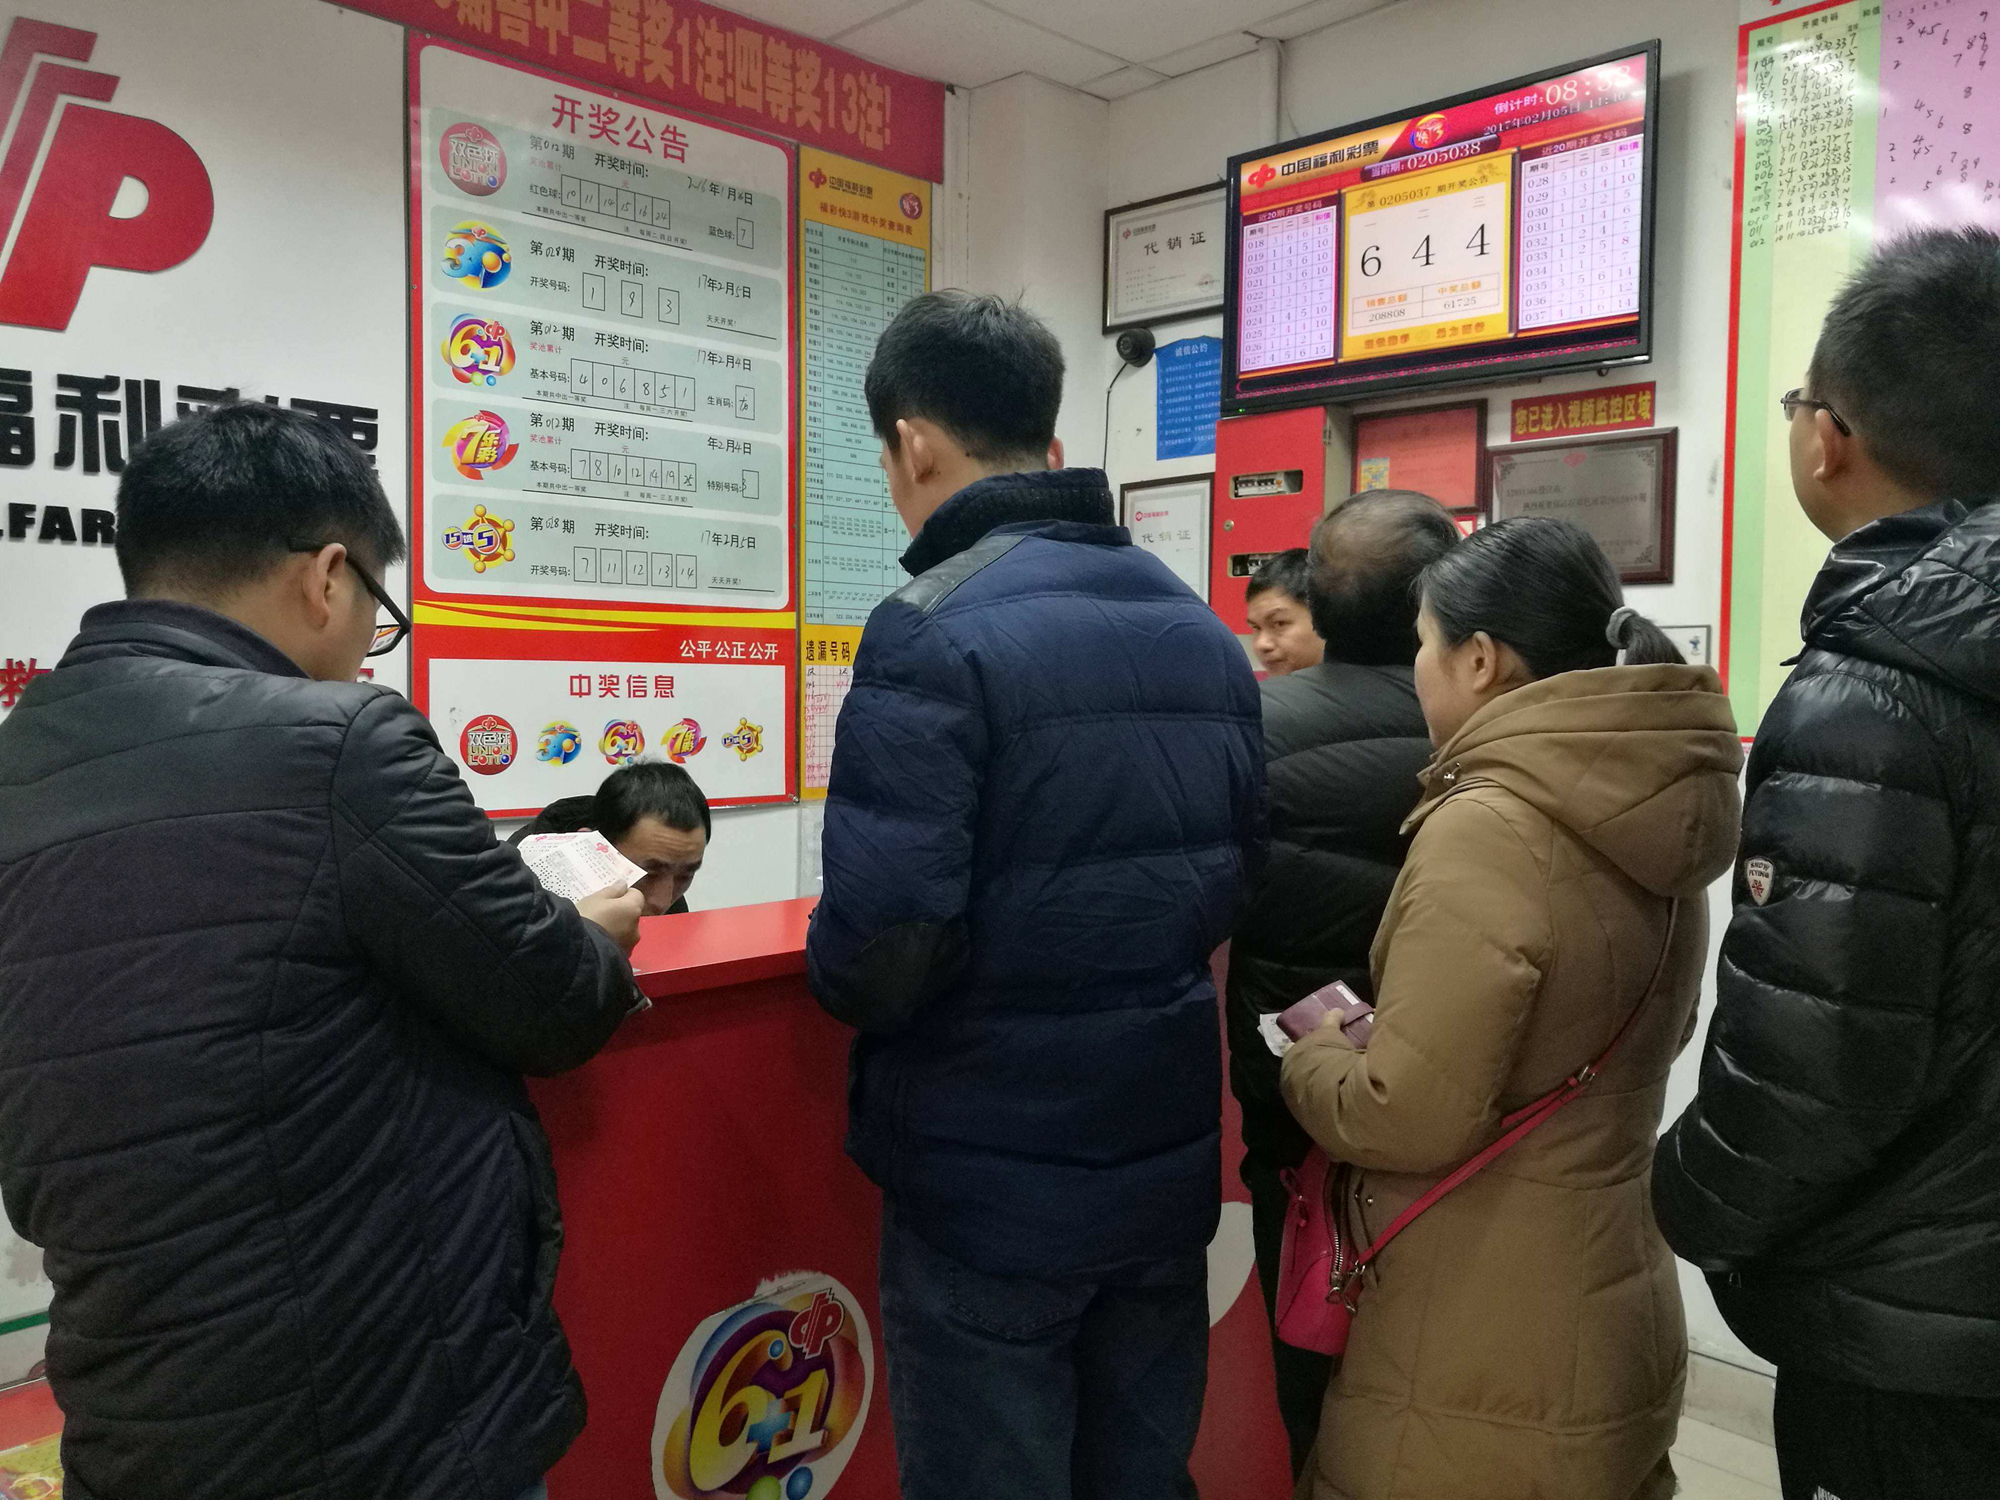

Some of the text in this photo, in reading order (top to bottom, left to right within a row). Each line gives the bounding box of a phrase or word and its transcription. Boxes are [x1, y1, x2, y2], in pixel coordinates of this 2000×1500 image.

[1953, 53, 1962, 67] 7
[1964, 86, 1973, 99] 8
[1914, 99, 1925, 111] 4
[551, 94, 690, 163] 开奖公告
[1937, 116, 1944, 129] 6
[1963, 123, 1973, 134] 8
[1542, 128, 1627, 156] 近20期开奖号码
[450, 140, 499, 162] 双色球
[1281, 139, 1379, 176] 中国福利彩票
[1407, 142, 1480, 170] 0205038
[595, 153, 649, 178] 开奖时间:
[1530, 162, 1548, 172] 期号
[1528, 177, 1548, 188] 028
[529, 184, 561, 199] 红色球:
[567, 190, 576, 199] 10
[1380, 187, 1431, 206] 0205037
[1437, 175, 1489, 193] 期开奖公告
[585, 194, 593, 203] 11
[1528, 192, 1548, 204] 029
[621, 202, 632, 211] 15
[639, 205, 647, 217] 16
[1527, 207, 1548, 219] 030
[655, 212, 668, 220] 24
[1527, 222, 1547, 233] 031
[1527, 237, 1547, 248] 032
[1361, 223, 1490, 277] 6 4 4
[1526, 251, 1547, 263] 033
[595, 255, 649, 277] 开奖时间:
[1526, 266, 1547, 278] 034
[530, 276, 570, 293] 开奖号码:
[1526, 282, 1547, 293] 035
[628, 292, 635, 307] 9
[1526, 297, 1546, 307] 036
[666, 299, 672, 315] 3
[1369, 297, 1477, 322] 208808 61725
[1525, 311, 1546, 322] 037
[595, 332, 649, 353] 开奖时间:
[530, 368, 570, 383] 基本号码:
[580, 374, 588, 384] 4
[620, 379, 626, 393] 6
[643, 383, 650, 395] 8
[659, 385, 670, 398] 5
[683, 388, 687, 398] 1
[1515, 390, 1652, 435] 您已进入视频监控区域
[595, 422, 649, 441] 开奖时间:
[530, 434, 562, 445] 奖池累计
[530, 460, 570, 474] 基本号码:
[579, 459, 586, 476] 7
[595, 459, 602, 476] 8
[613, 464, 621, 477] 10
[631, 467, 641, 478] 12
[650, 469, 658, 483] 14
[666, 470, 675, 484] 19
[707, 480, 741, 493] 特别号码:
[595, 523, 649, 540] 开奖时间:
[530, 565, 570, 577] 开奖号码:
[582, 558, 588, 573] 7
[607, 563, 616, 573] 11
[633, 565, 644, 575] 12
[658, 565, 670, 579] 13
[681, 568, 694, 577] 14
[570, 674, 675, 699] 中奖信息
[468, 732, 510, 746] 双色球
[468, 745, 512, 755] UNION
[468, 754, 511, 766] LOTTO
